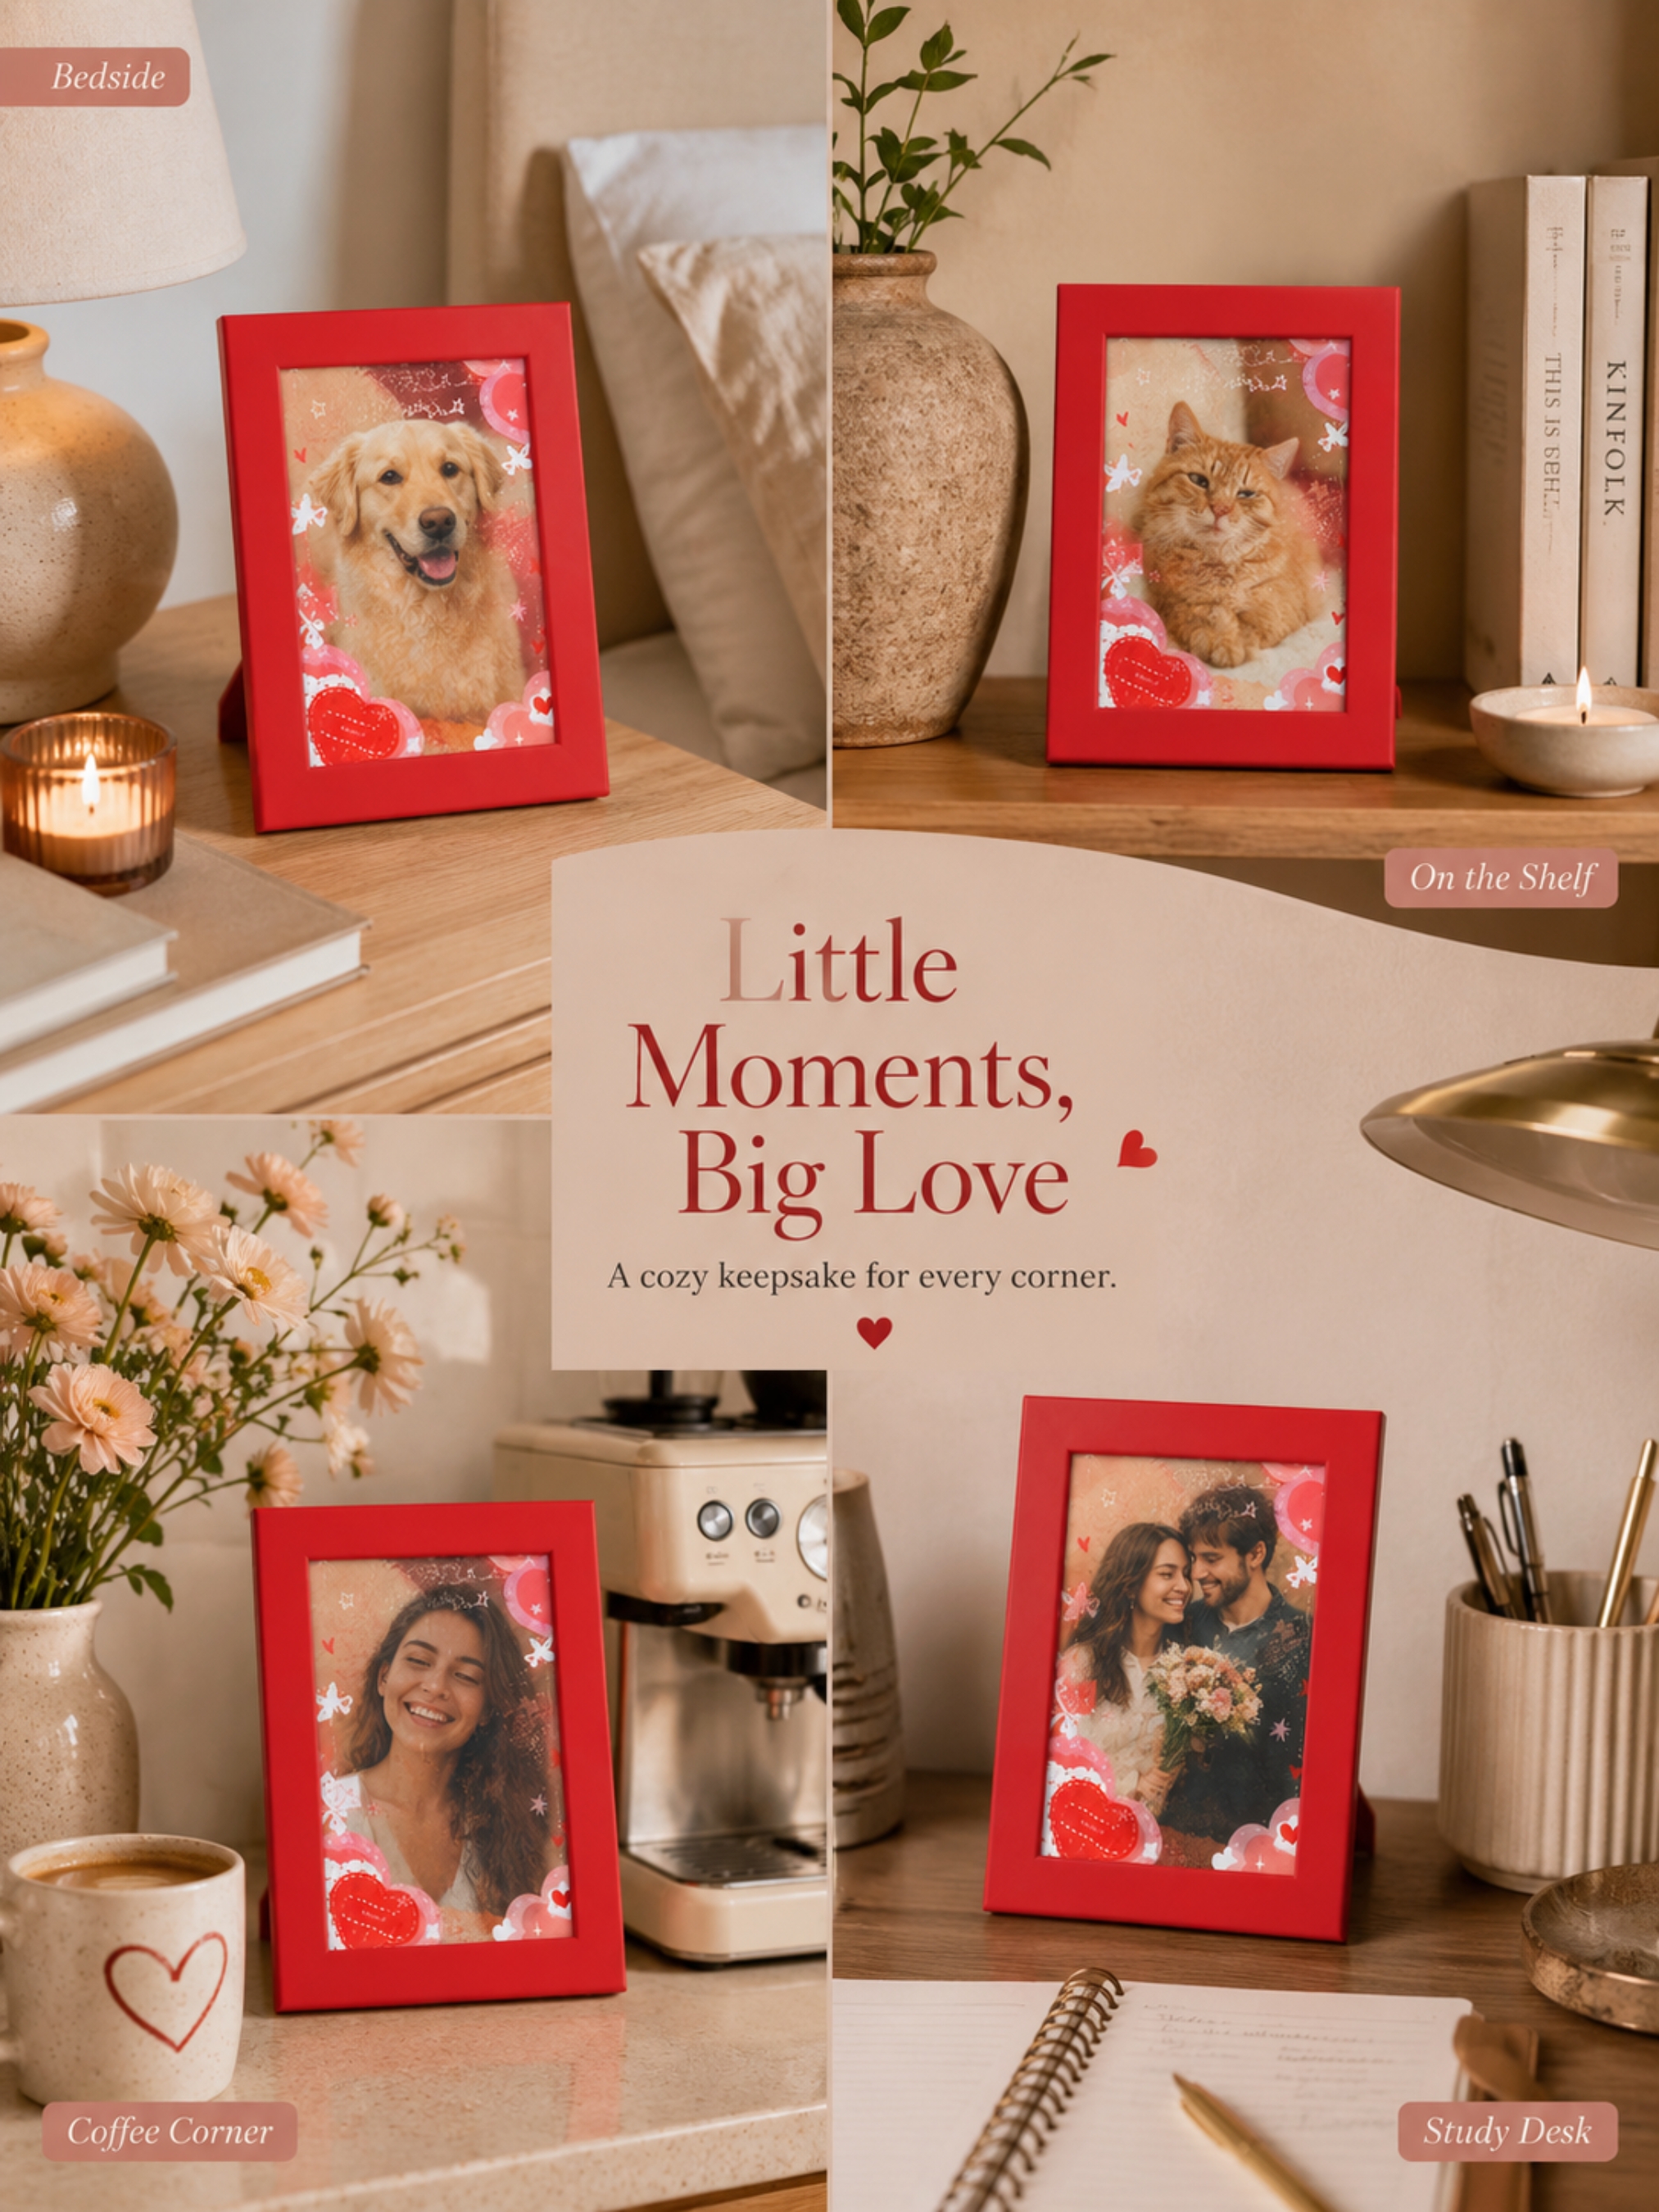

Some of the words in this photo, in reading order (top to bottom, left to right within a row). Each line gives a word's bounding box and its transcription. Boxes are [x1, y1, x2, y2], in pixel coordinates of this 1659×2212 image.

[1544, 352, 1562, 408] THIS
[1543, 415, 1561, 437] IS
[1603, 360, 1627, 515] KINFOLK
